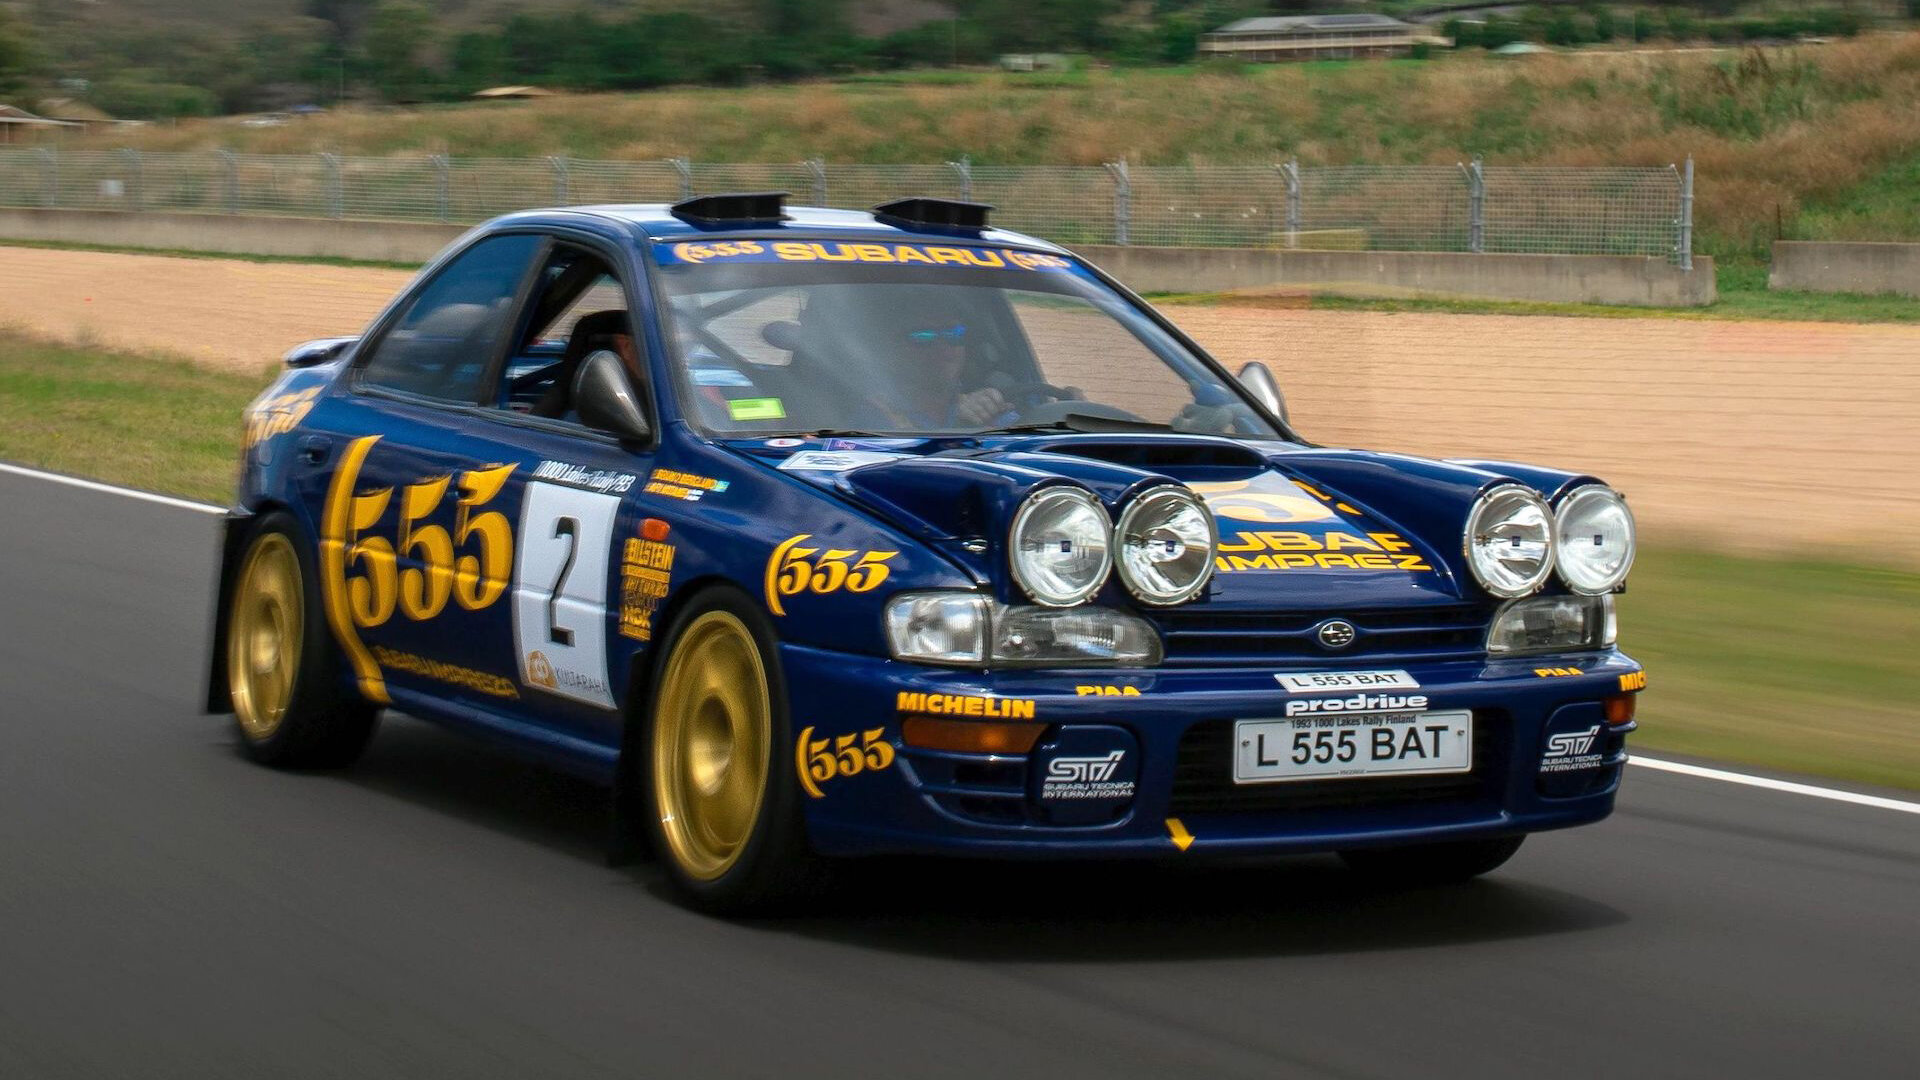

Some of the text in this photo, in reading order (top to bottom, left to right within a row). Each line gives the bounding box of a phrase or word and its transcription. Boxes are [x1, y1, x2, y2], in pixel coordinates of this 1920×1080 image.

[771, 242, 1006, 268] SUBARU
[1215, 553, 1432, 572] IMPREZ
[549, 516, 581, 647] 2
[1291, 677, 1310, 687] L
[1312, 674, 1351, 687] 555
[1356, 673, 1401, 685] BAT
[1075, 685, 1142, 697] PIAA
[896, 691, 1035, 719] MICHELIN
[1285, 693, 1428, 717] prodrive
[1291, 714, 1417, 729] 1993 1000 Lakes Rally Finland
[1256, 725, 1449, 767] L 555 BAT
[1540, 761, 1602, 773] INTERNATIONAL
[1542, 757, 1574, 766] SUBARU
[1042, 789, 1134, 799] INTERNATIONAL
[1043, 783, 1089, 791] SUBARU
